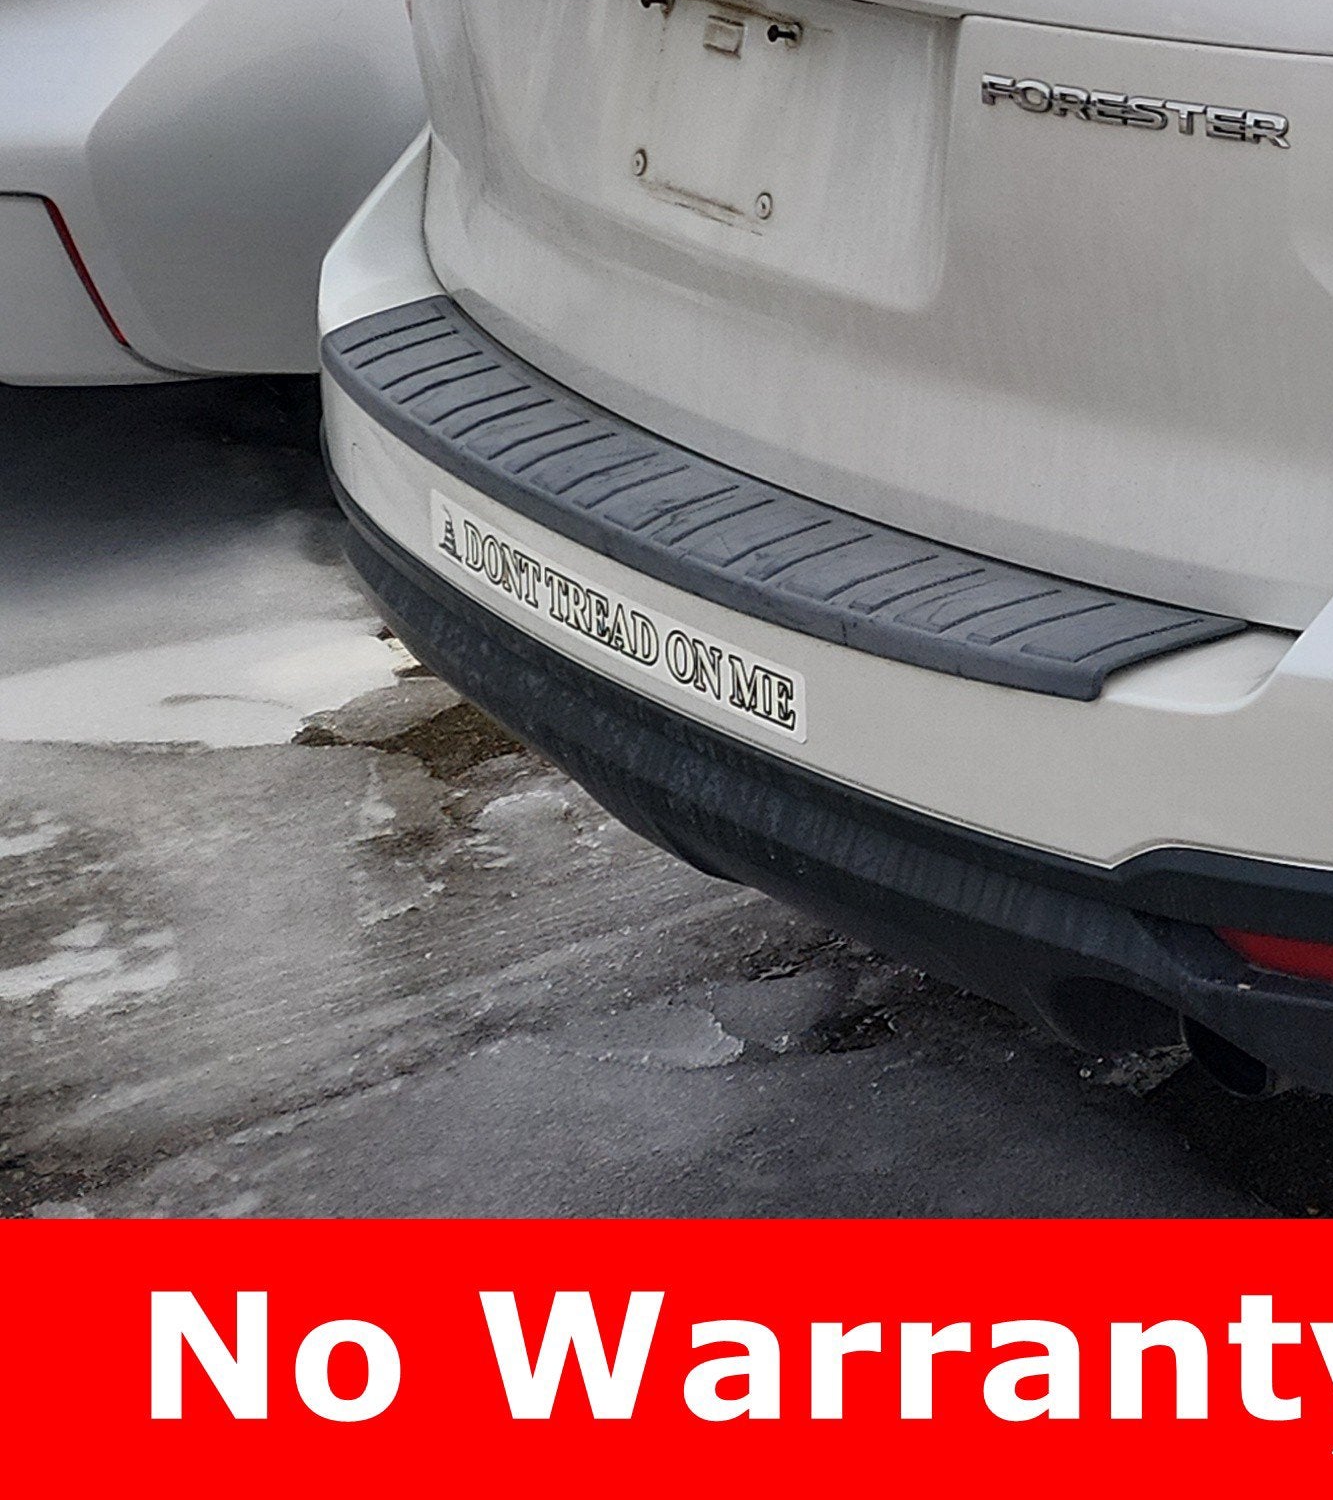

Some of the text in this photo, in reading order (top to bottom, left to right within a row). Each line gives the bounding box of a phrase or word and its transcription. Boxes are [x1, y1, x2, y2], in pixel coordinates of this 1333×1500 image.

[980, 72, 1292, 150] FORESTER
[464, 520, 797, 731] DONT TREAD ON ME
